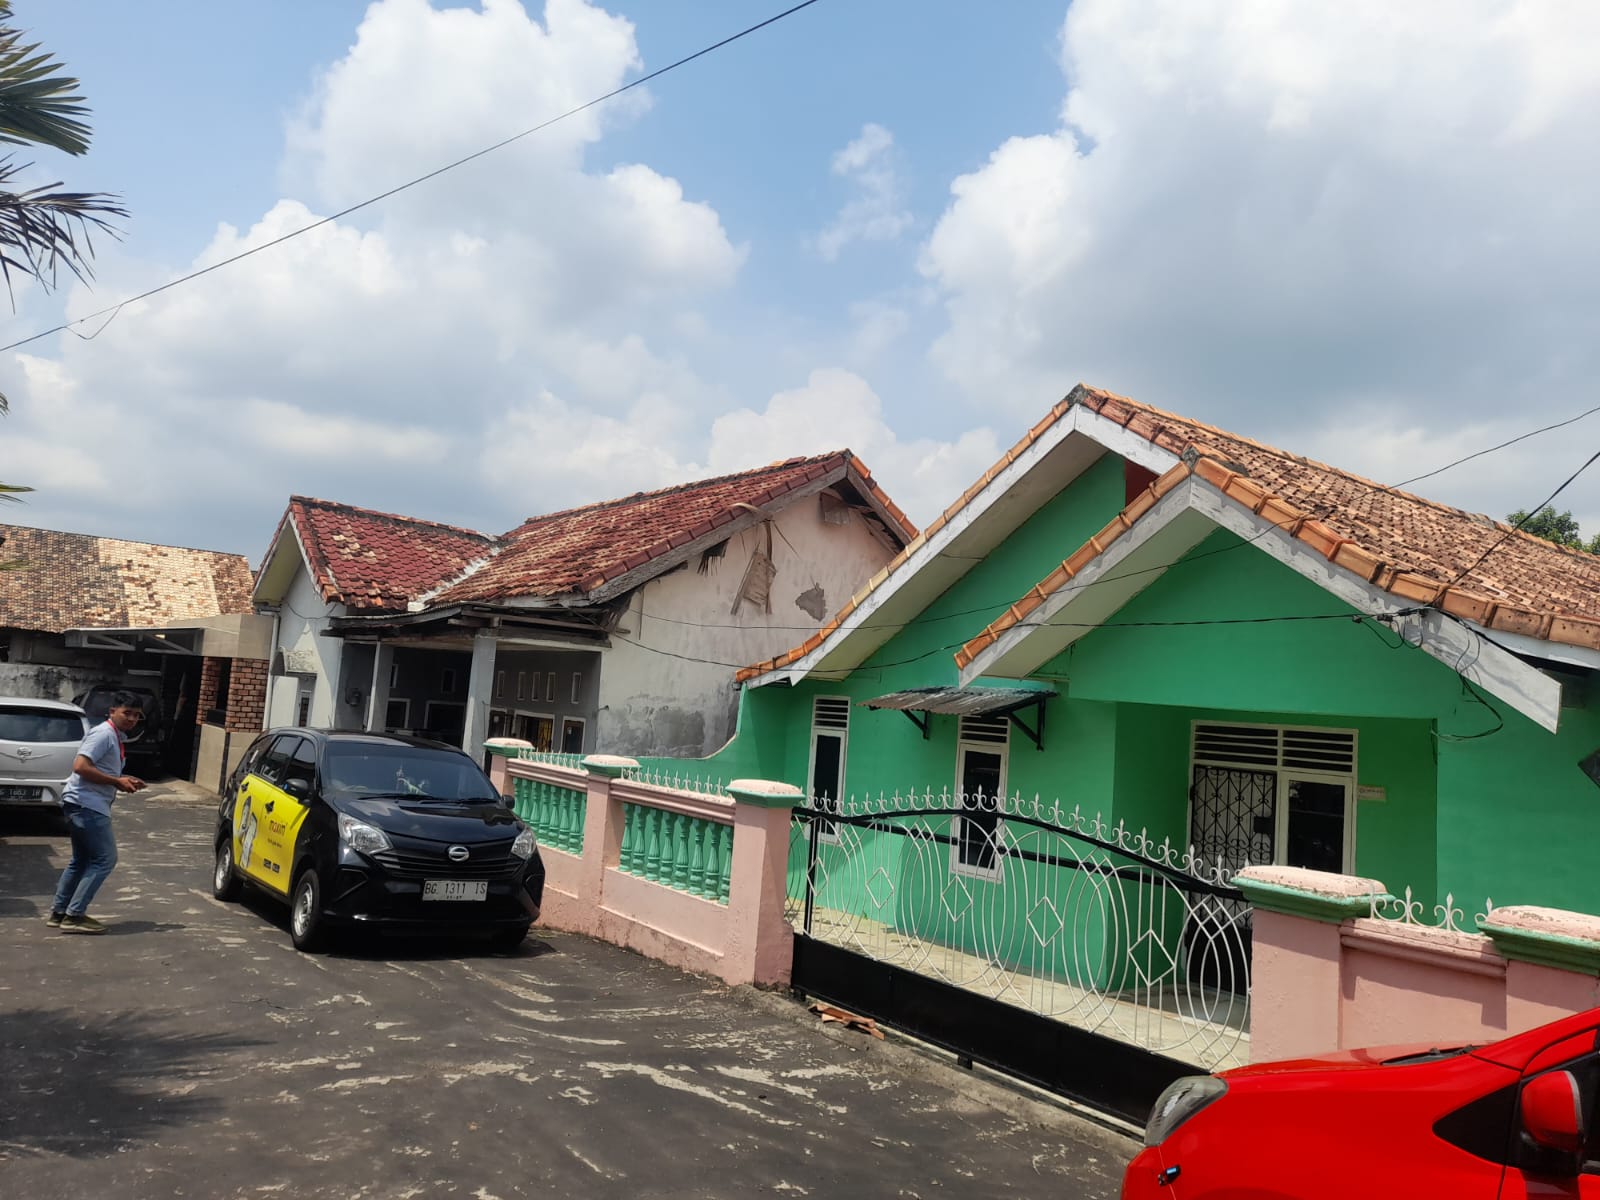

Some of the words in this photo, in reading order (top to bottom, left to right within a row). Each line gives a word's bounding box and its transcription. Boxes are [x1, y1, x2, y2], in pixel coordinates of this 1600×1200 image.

[425, 882, 438, 894] BG
[445, 882, 466, 894] 1311
[475, 882, 487, 894] IS
